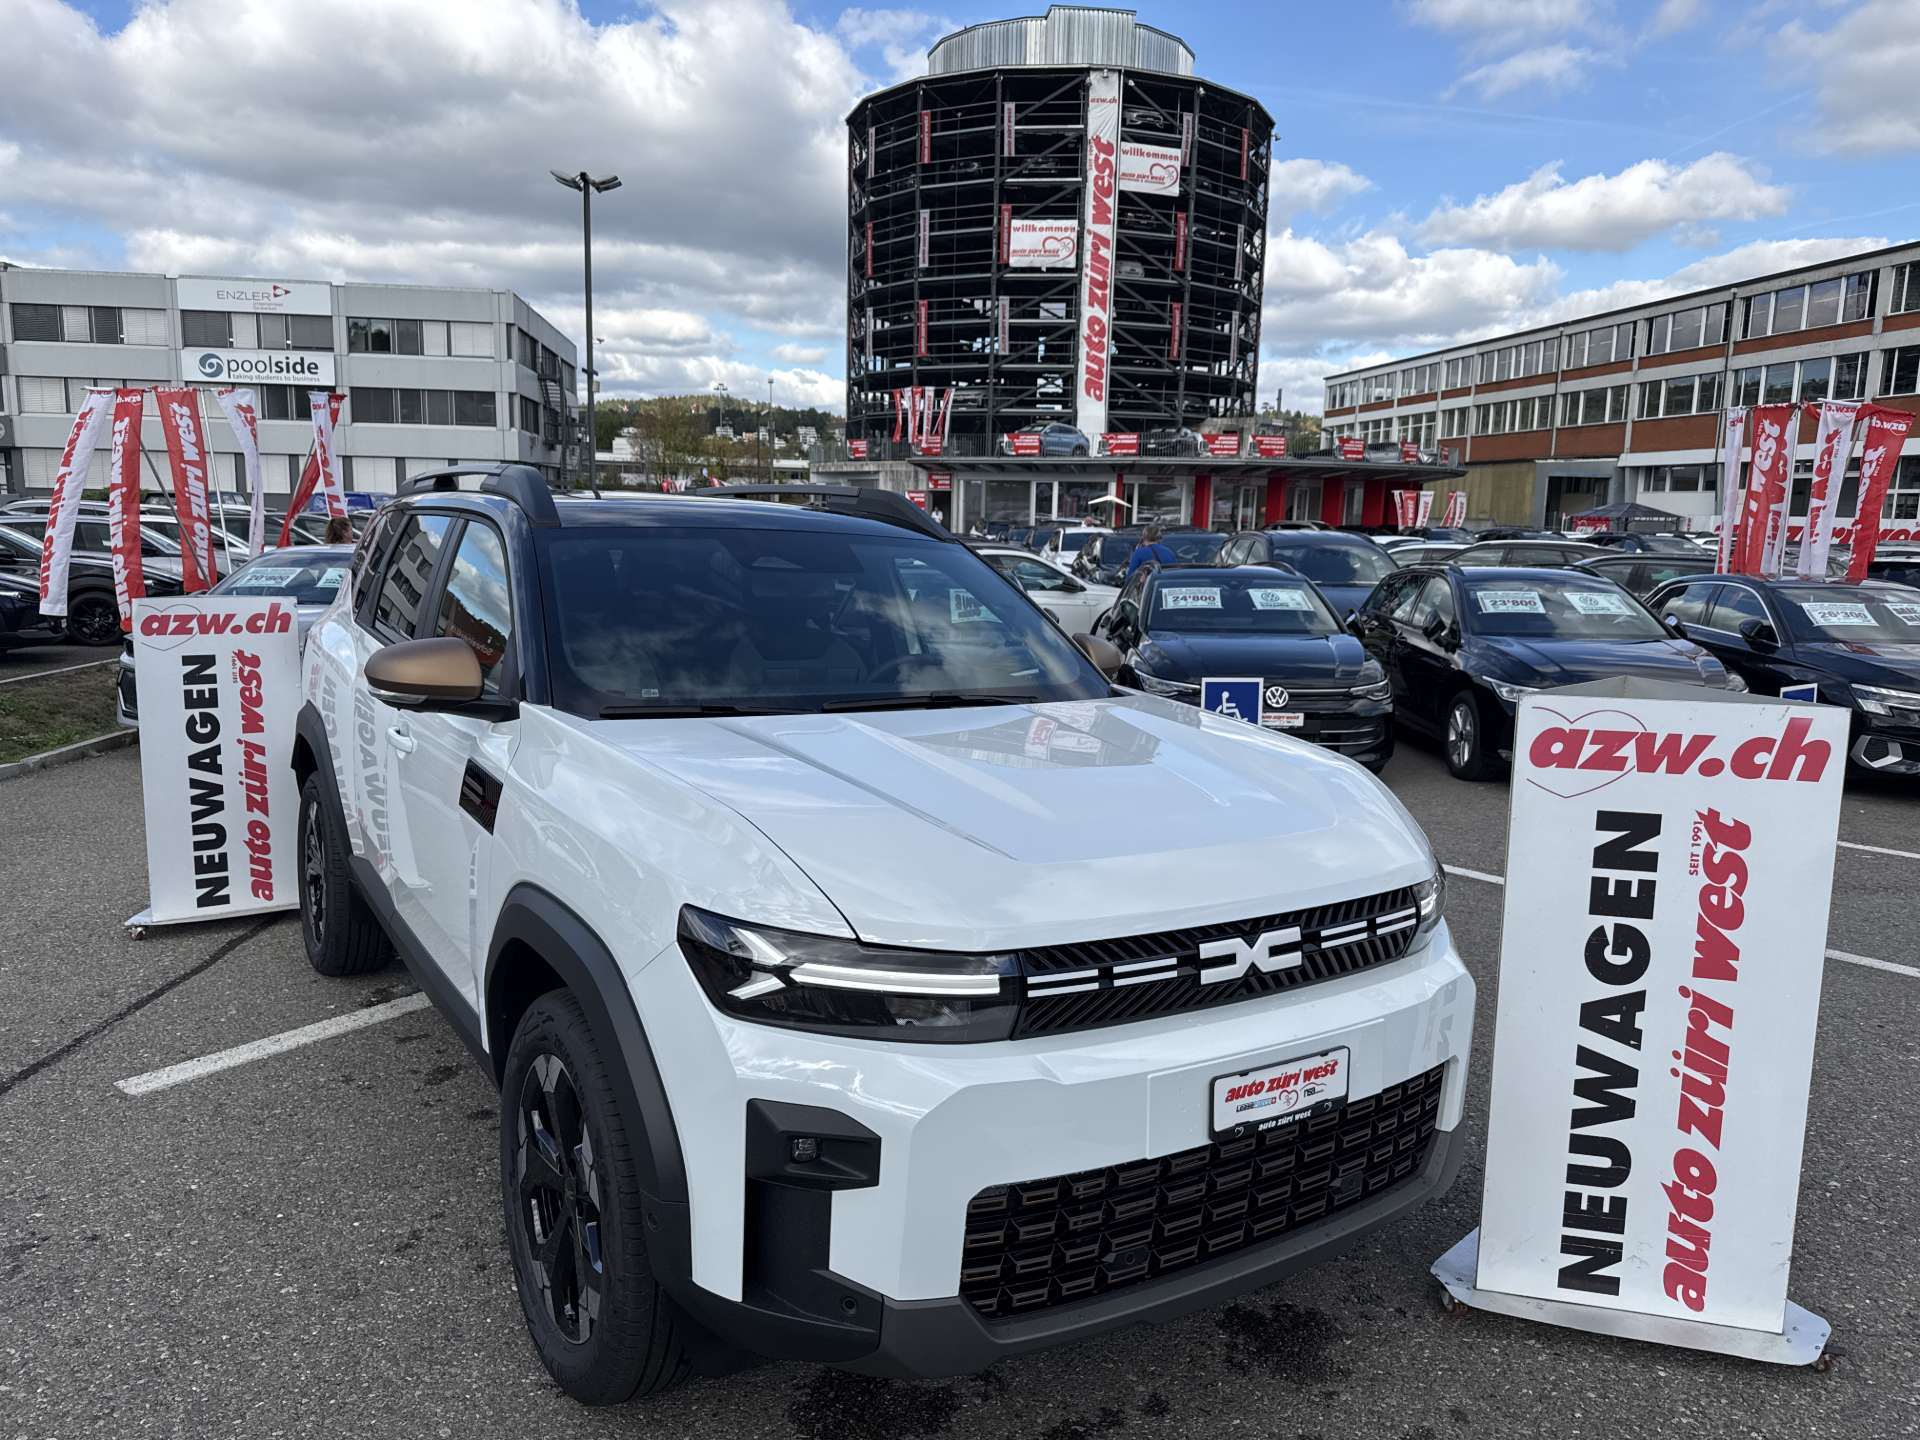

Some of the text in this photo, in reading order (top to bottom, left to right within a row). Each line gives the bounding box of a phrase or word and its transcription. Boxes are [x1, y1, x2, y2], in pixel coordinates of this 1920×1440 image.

[1121, 147, 1180, 162] willkommen
[1012, 224, 1076, 233] willkommen
[216, 290, 271, 301] ENZLER
[1083, 134, 1115, 402] auto züri west
[227, 355, 319, 379] poolside
[233, 373, 254, 381] taking
[293, 374, 320, 382] business
[169, 402, 200, 461] west
[1750, 419, 1780, 493] west
[180, 463, 209, 522] züri
[140, 603, 293, 637] azw.ch
[1489, 599, 1537, 607] 23'800
[234, 648, 275, 902] auto züri west
[1528, 716, 1832, 783] azw.ch
[181, 654, 231, 908] NEUWAGEN
[1689, 821, 1703, 877] SEIT 1991
[1225, 1059, 1338, 1103] auto züri west
[1557, 809, 1663, 1297] NEUWAGEN
[1659, 807, 1753, 1314] auto züri west
[1258, 1109, 1312, 1131] auto züri west
